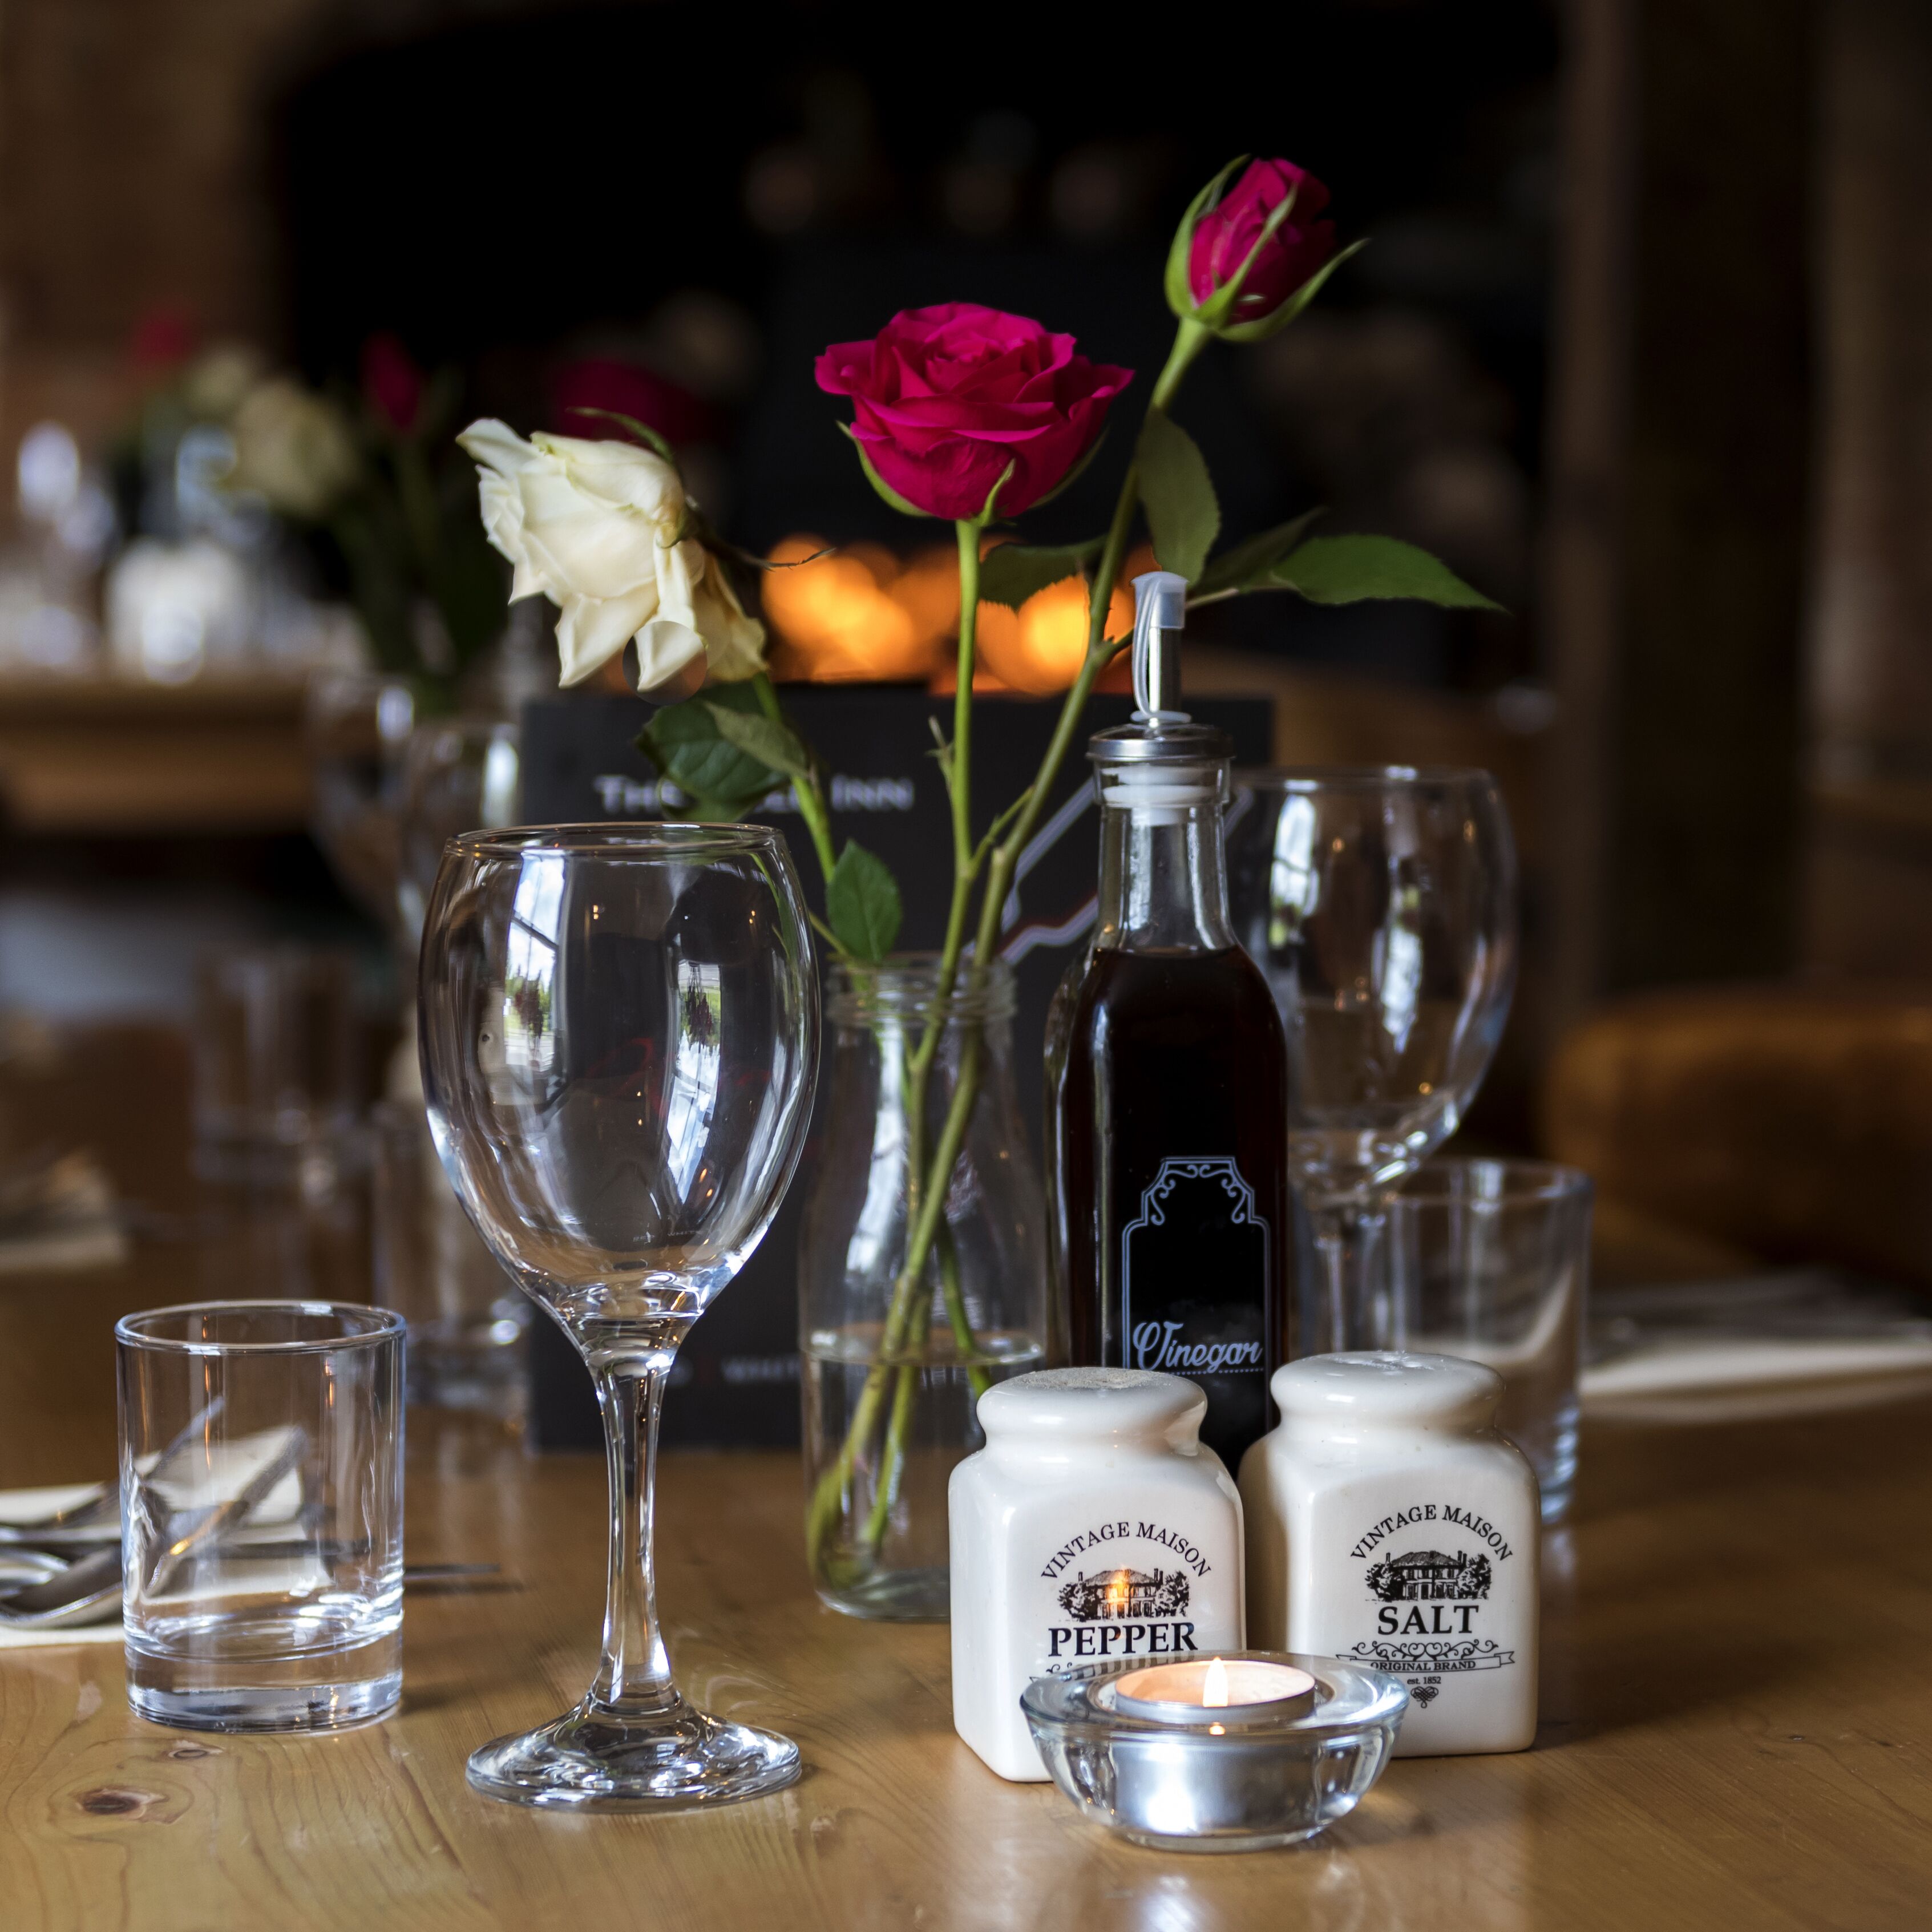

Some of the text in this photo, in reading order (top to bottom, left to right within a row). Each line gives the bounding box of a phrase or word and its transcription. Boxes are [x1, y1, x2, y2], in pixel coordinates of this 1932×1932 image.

[830, 773, 915, 811] INN
[1133, 1320, 1263, 1374] Vinegar
[1041, 1521, 1211, 1581] VINTAGE MAISON
[1350, 1504, 1513, 1562] VINTAGE MAISON
[1377, 1604, 1480, 1636] SALT
[1048, 1622, 1198, 1657] PEPPER
[1423, 1676, 1442, 1684] 1852
[1433, 1660, 1476, 1670] BRAND
